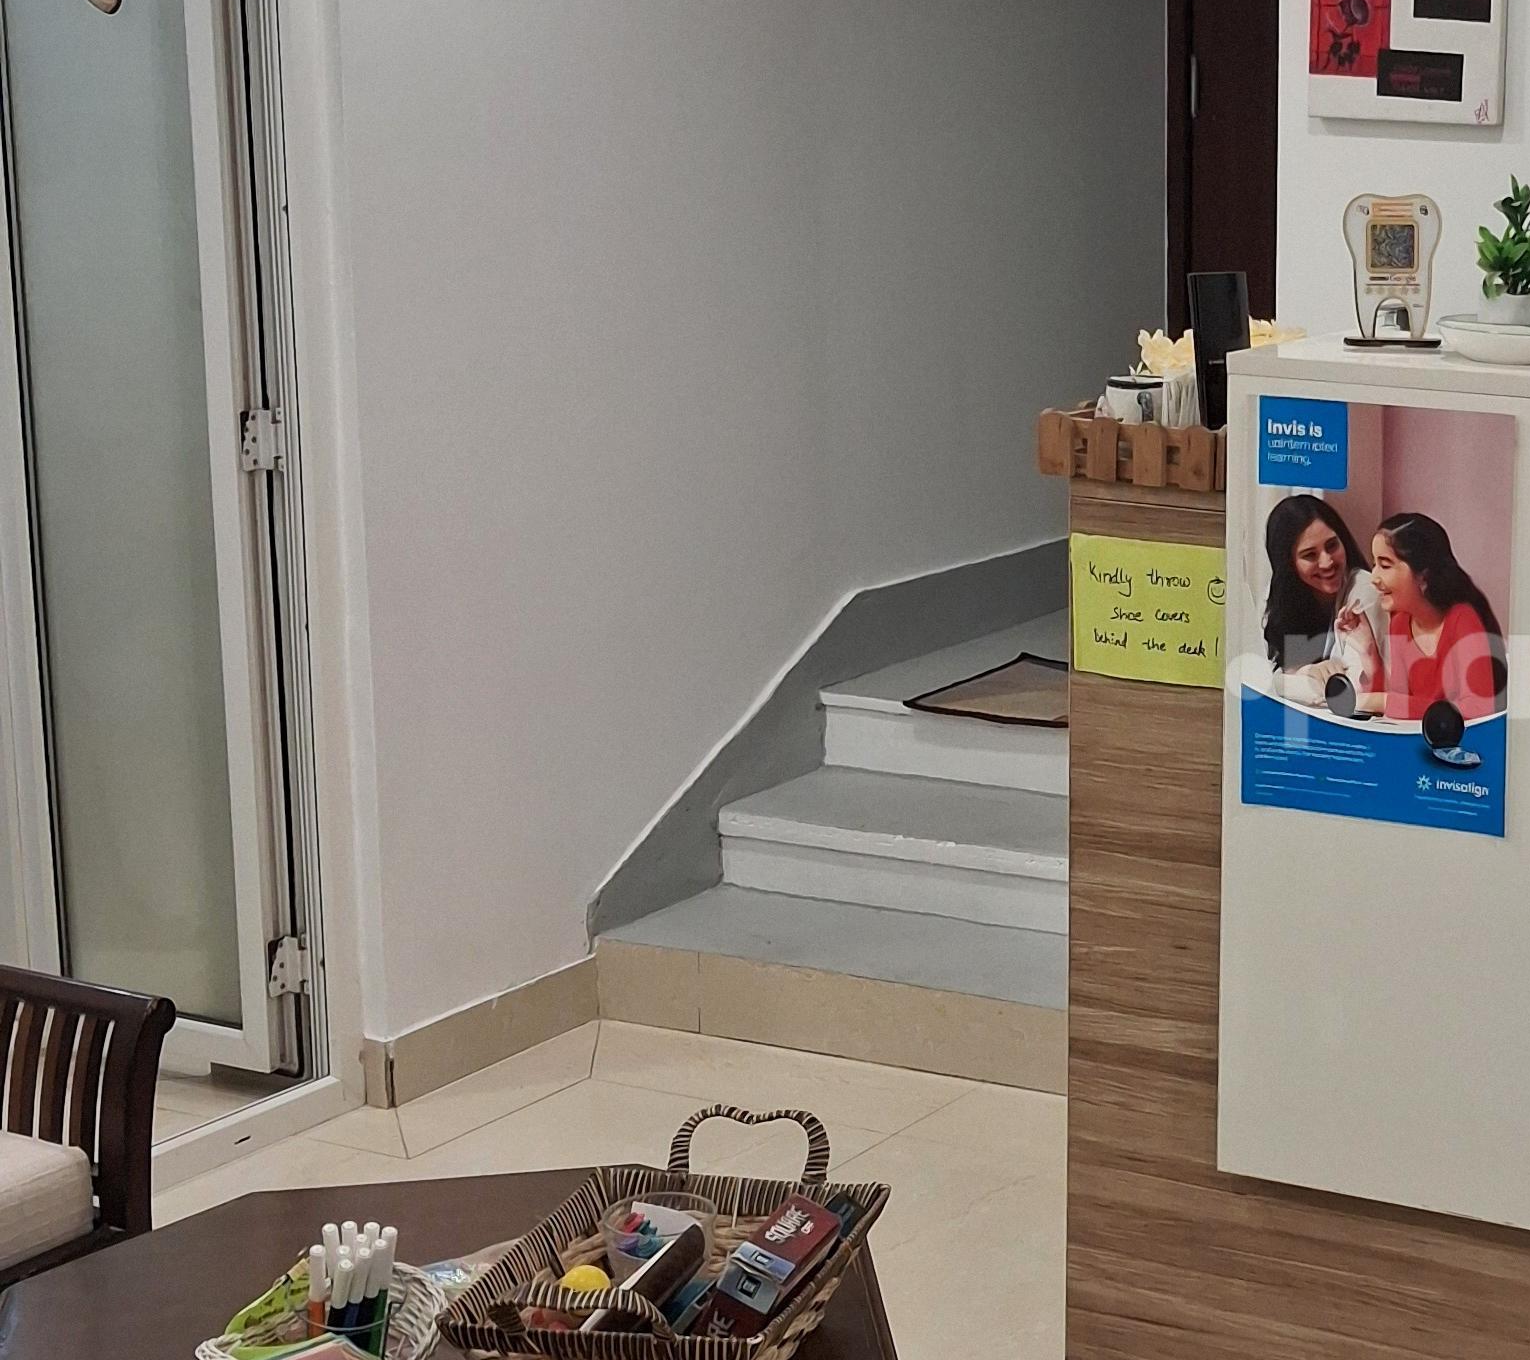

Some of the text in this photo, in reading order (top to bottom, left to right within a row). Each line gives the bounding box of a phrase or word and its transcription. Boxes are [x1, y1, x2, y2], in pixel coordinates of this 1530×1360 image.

[1267, 418, 1323, 438] Invis is
[1089, 561, 1191, 598] Kindly throw
[1094, 628, 1128, 649] behind
[1142, 638, 1167, 652] the
[1436, 779, 1489, 798] invisalign
